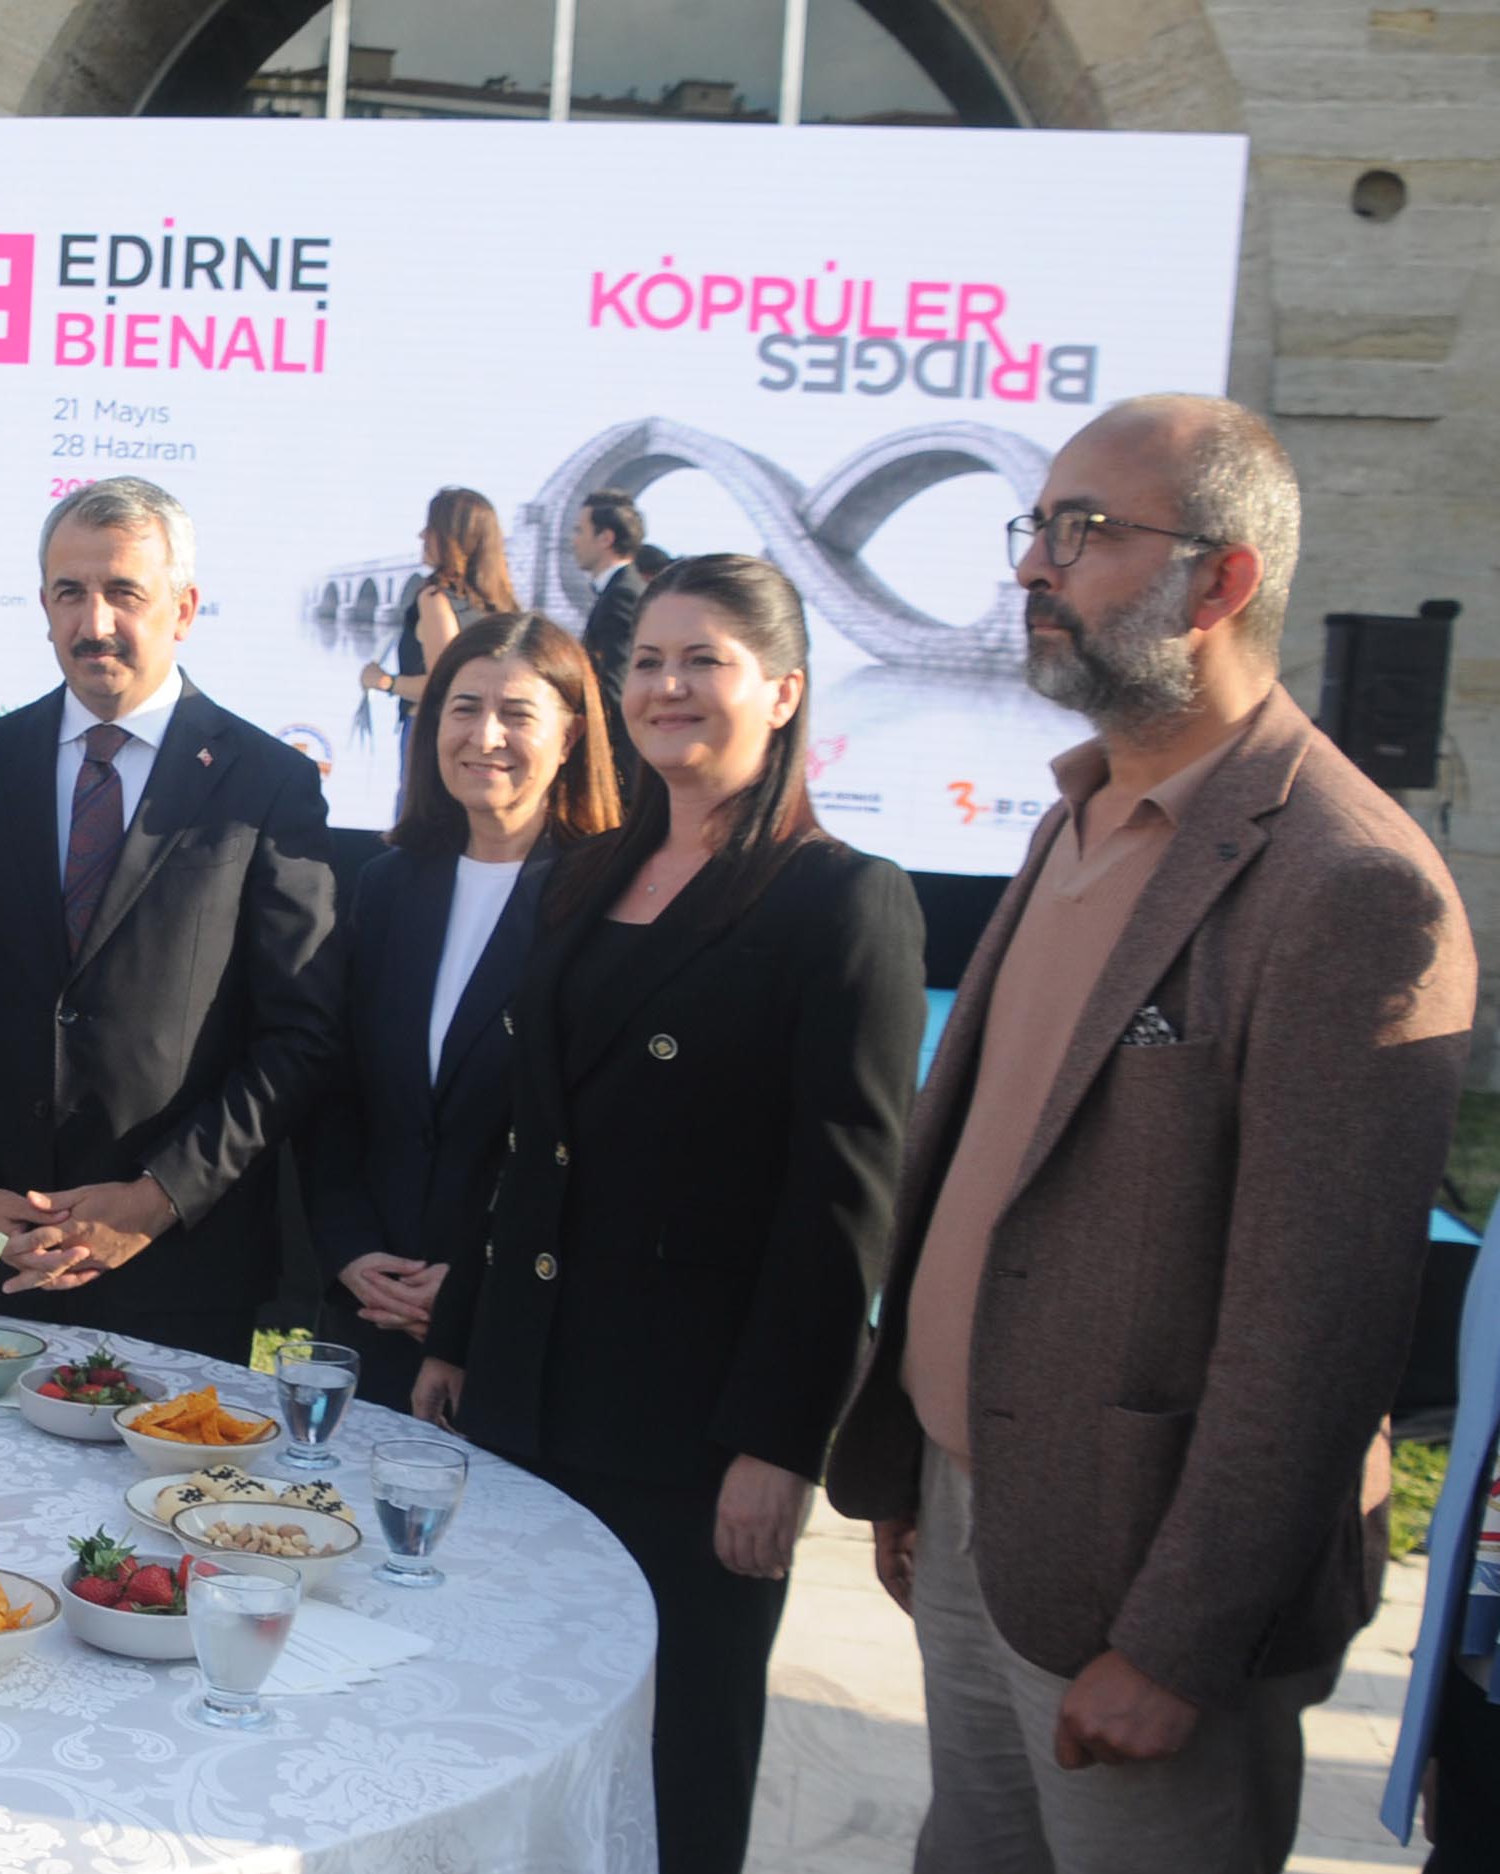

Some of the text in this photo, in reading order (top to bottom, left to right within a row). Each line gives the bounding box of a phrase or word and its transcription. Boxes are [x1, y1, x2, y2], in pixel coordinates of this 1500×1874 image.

[59, 218, 332, 293] EDİRNE
[55, 296, 329, 374] BİENALİ
[758, 332, 1100, 405] BRIDGES
[52, 433, 198, 462] 28 Haziran
[53, 398, 173, 428] 21 Mayıs
